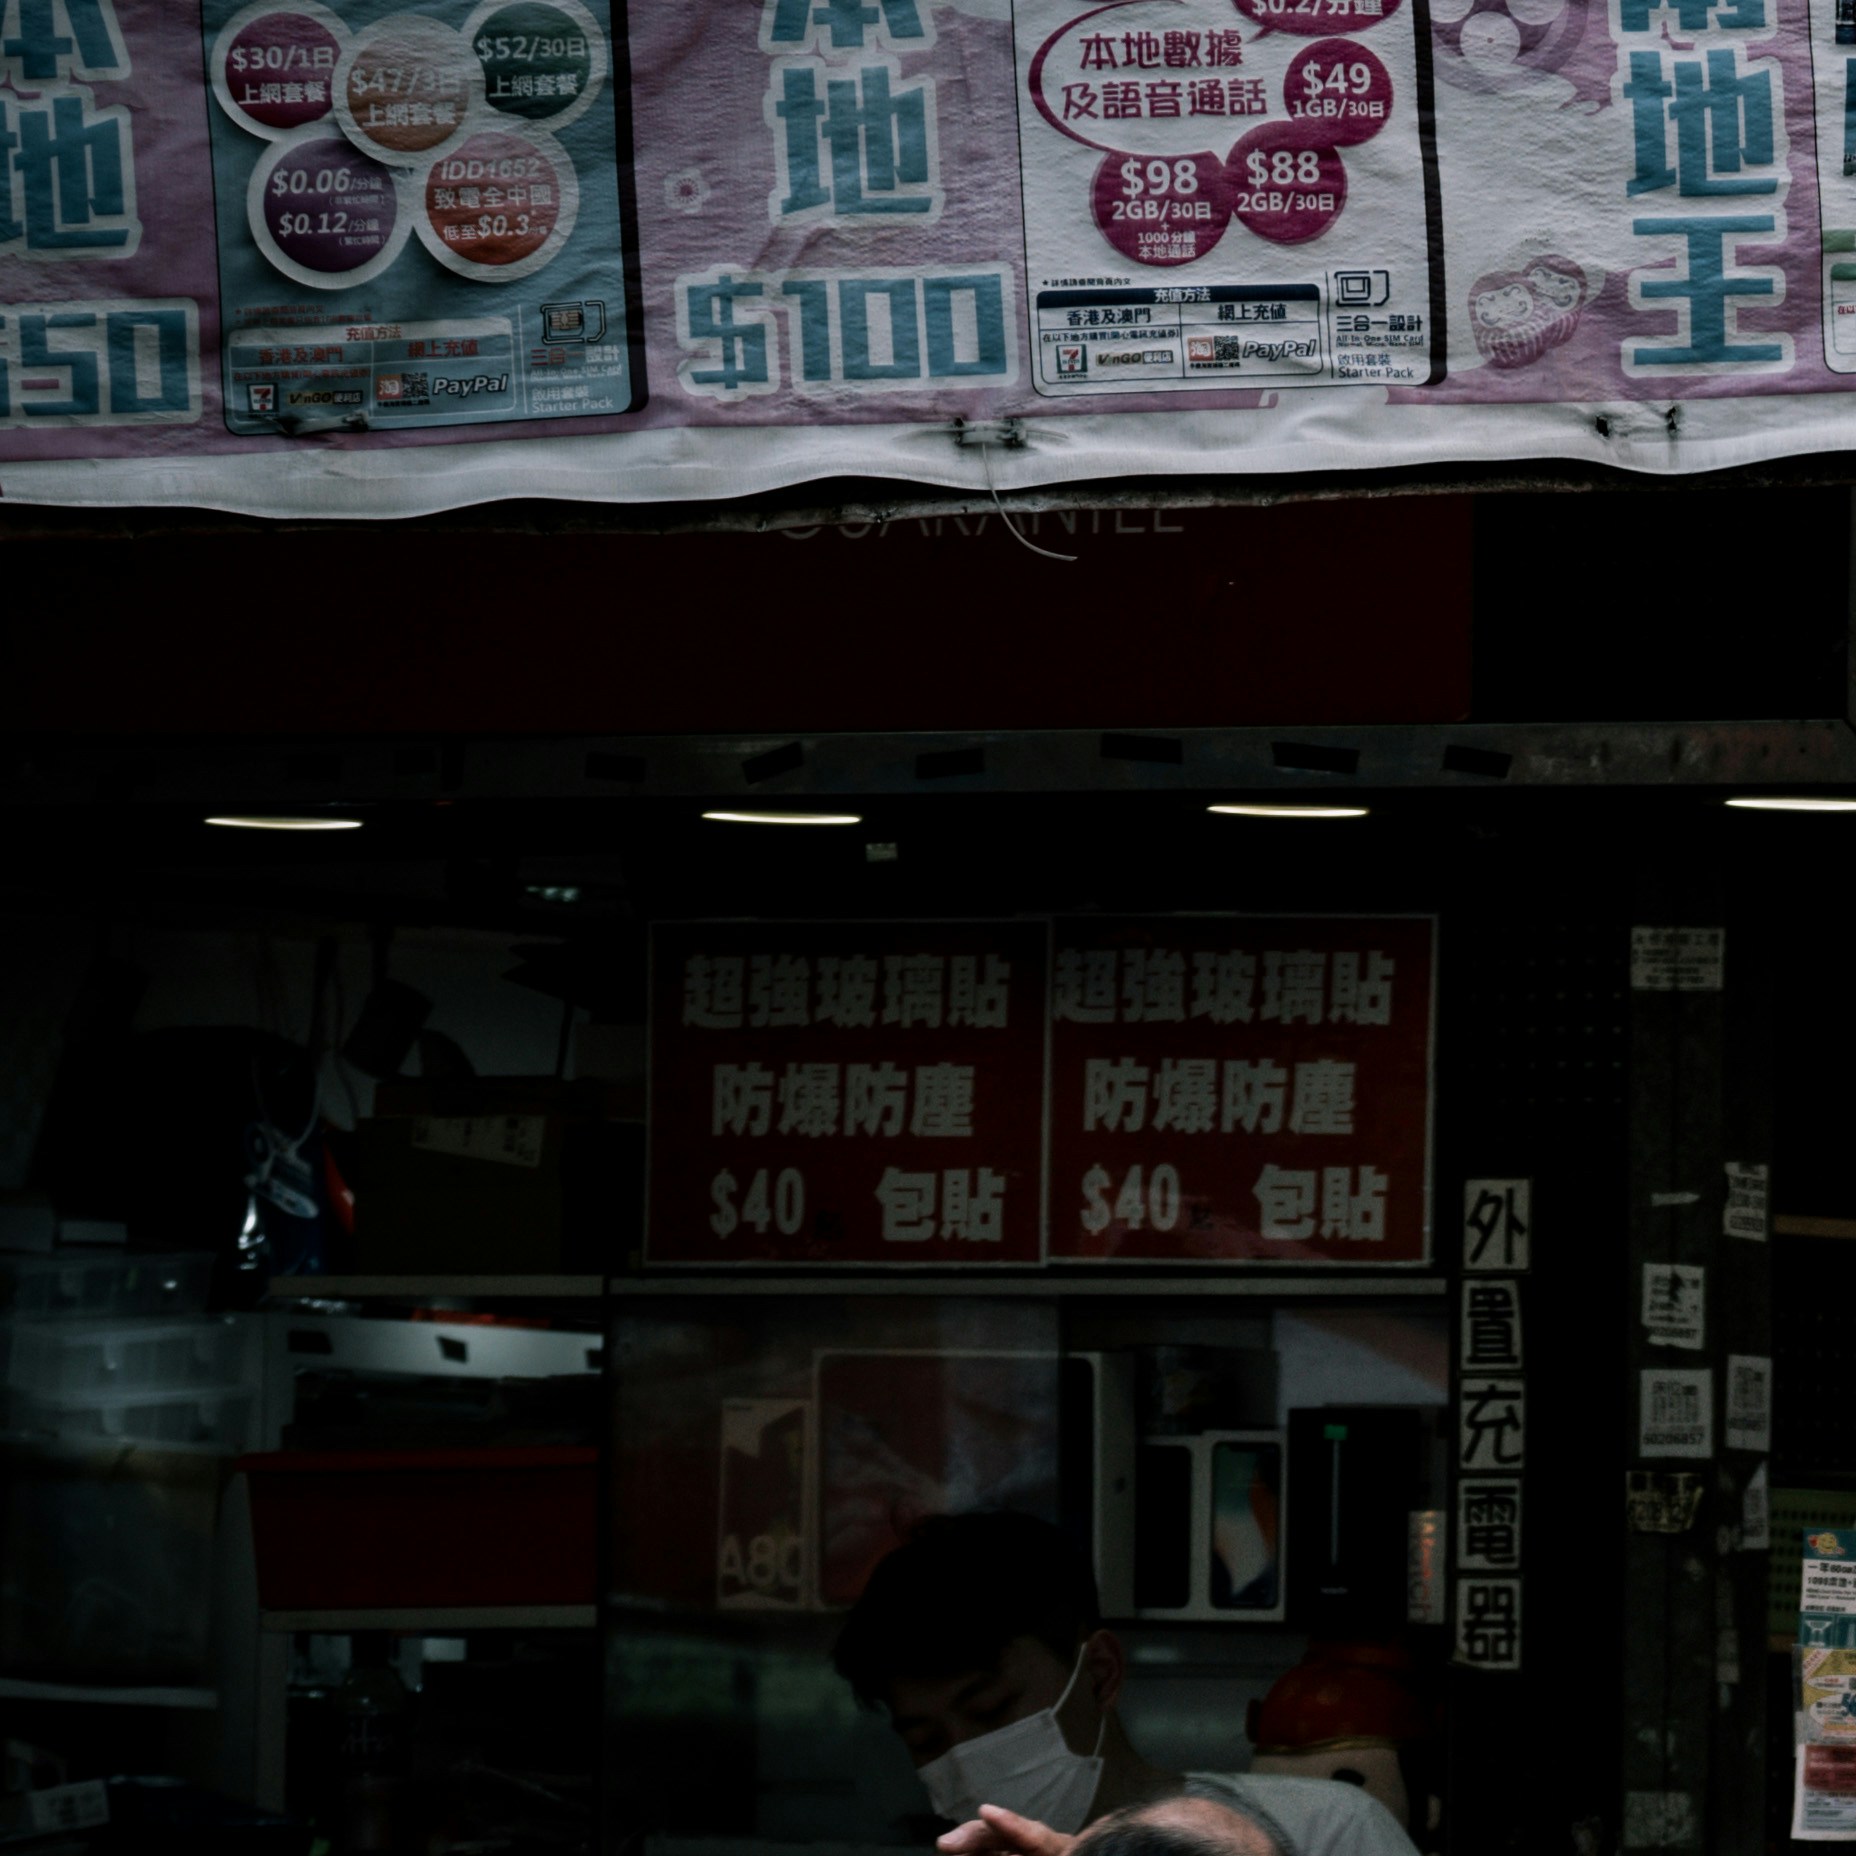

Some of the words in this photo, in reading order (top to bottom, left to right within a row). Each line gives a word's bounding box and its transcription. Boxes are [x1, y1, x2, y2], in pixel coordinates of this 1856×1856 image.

[232, 45, 334, 71] $30/1日
[477, 35, 585, 61] $52/30日
[1079, 30, 1244, 70] 本地數據
[488, 73, 578, 98] 上網套餐
[1302, 61, 1371, 96] $49
[238, 80, 327, 105] 上網套餐
[1061, 77, 1267, 120] 及語音通話
[363, 102, 456, 127] 上網套餐
[1292, 98, 1385, 119] 1GB/30日
[1121, 159, 1199, 198] $98
[1246, 149, 1321, 186] $88
[272, 168, 383, 195] $0.06/分鐘
[1617, 0, 1782, 365] 地王
[434, 185, 552, 210] 致電全中國
[1236, 191, 1335, 213] 2GB/30日
[1111, 200, 1212, 222] 2GB/30日
[278, 212, 380, 236] $0.12/分鐘
[1137, 230, 1196, 245] 1000分鐘
[1138, 244, 1196, 260] 本地通話
[1154, 287, 1211, 303] 充值方法
[1067, 308, 1152, 325] 香港及澳門
[1218, 303, 1287, 321] 網上充值
[1336, 315, 1423, 332] 三合一設計
[687, 273, 1007, 389] $100
[258, 347, 343, 364] 香港及澳門
[408, 340, 478, 357] 網上充值
[530, 345, 619, 366] 三合一設計
[1242, 339, 1317, 359] PayPal
[0, 308, 190, 415] 50
[1338, 365, 1383, 379] Starter
[1386, 365, 1414, 378] Pack
[433, 374, 508, 395] PayPal
[532, 398, 577, 413] Starter
[581, 396, 614, 410] Pack
[682, 953, 1012, 1029] 超強玻璃貼
[1052, 948, 1396, 1026] 超強玻璃貼
[711, 1061, 977, 1138] 防爆防塵
[1080, 1056, 1358, 1135] 防爆防塵
[709, 1167, 806, 1239] $40
[873, 1166, 1008, 1243] 包貼
[1080, 1162, 1181, 1236] $40
[1251, 1162, 1391, 1243] 包貼
[1463, 1186, 1526, 1664] 外置充電器
